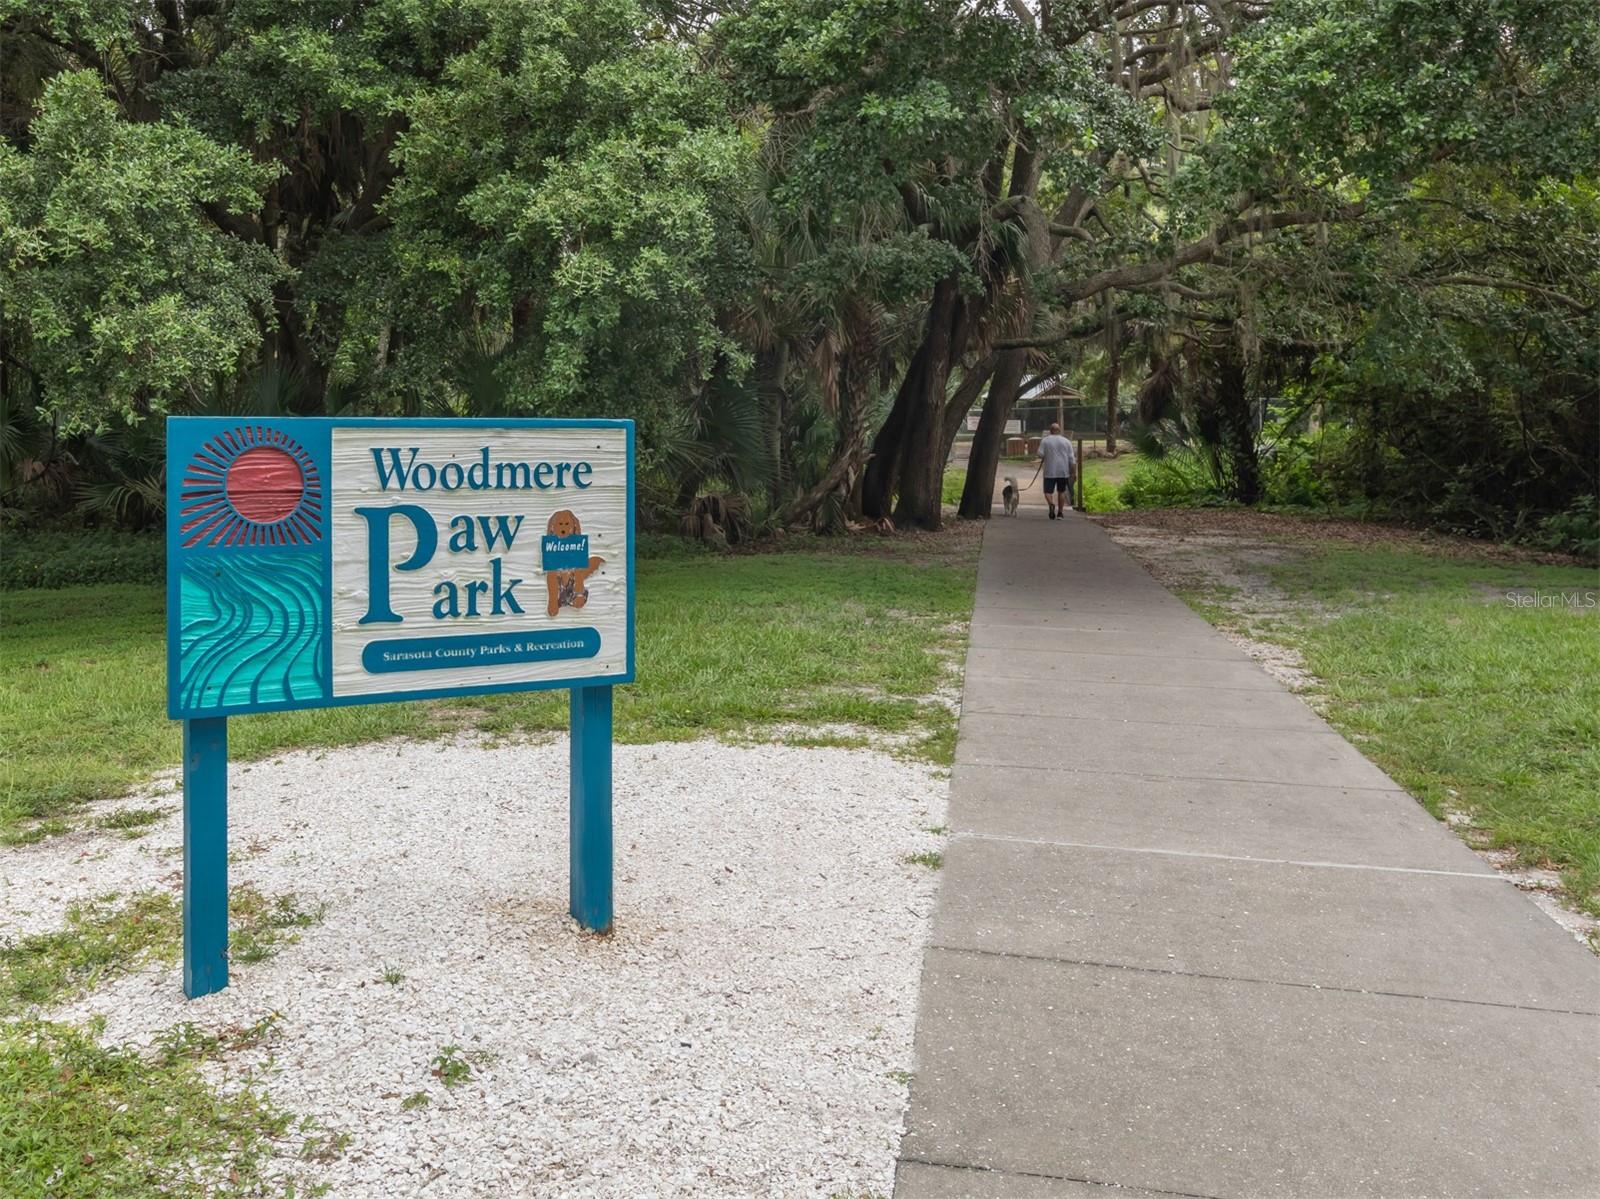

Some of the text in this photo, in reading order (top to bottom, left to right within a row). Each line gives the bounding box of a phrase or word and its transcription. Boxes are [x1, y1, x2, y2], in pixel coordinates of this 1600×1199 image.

[370, 447, 592, 491] Woodmere
[545, 538, 586, 552] Welcome!
[383, 638, 585, 662] Sarasota County Parks & Recreation
